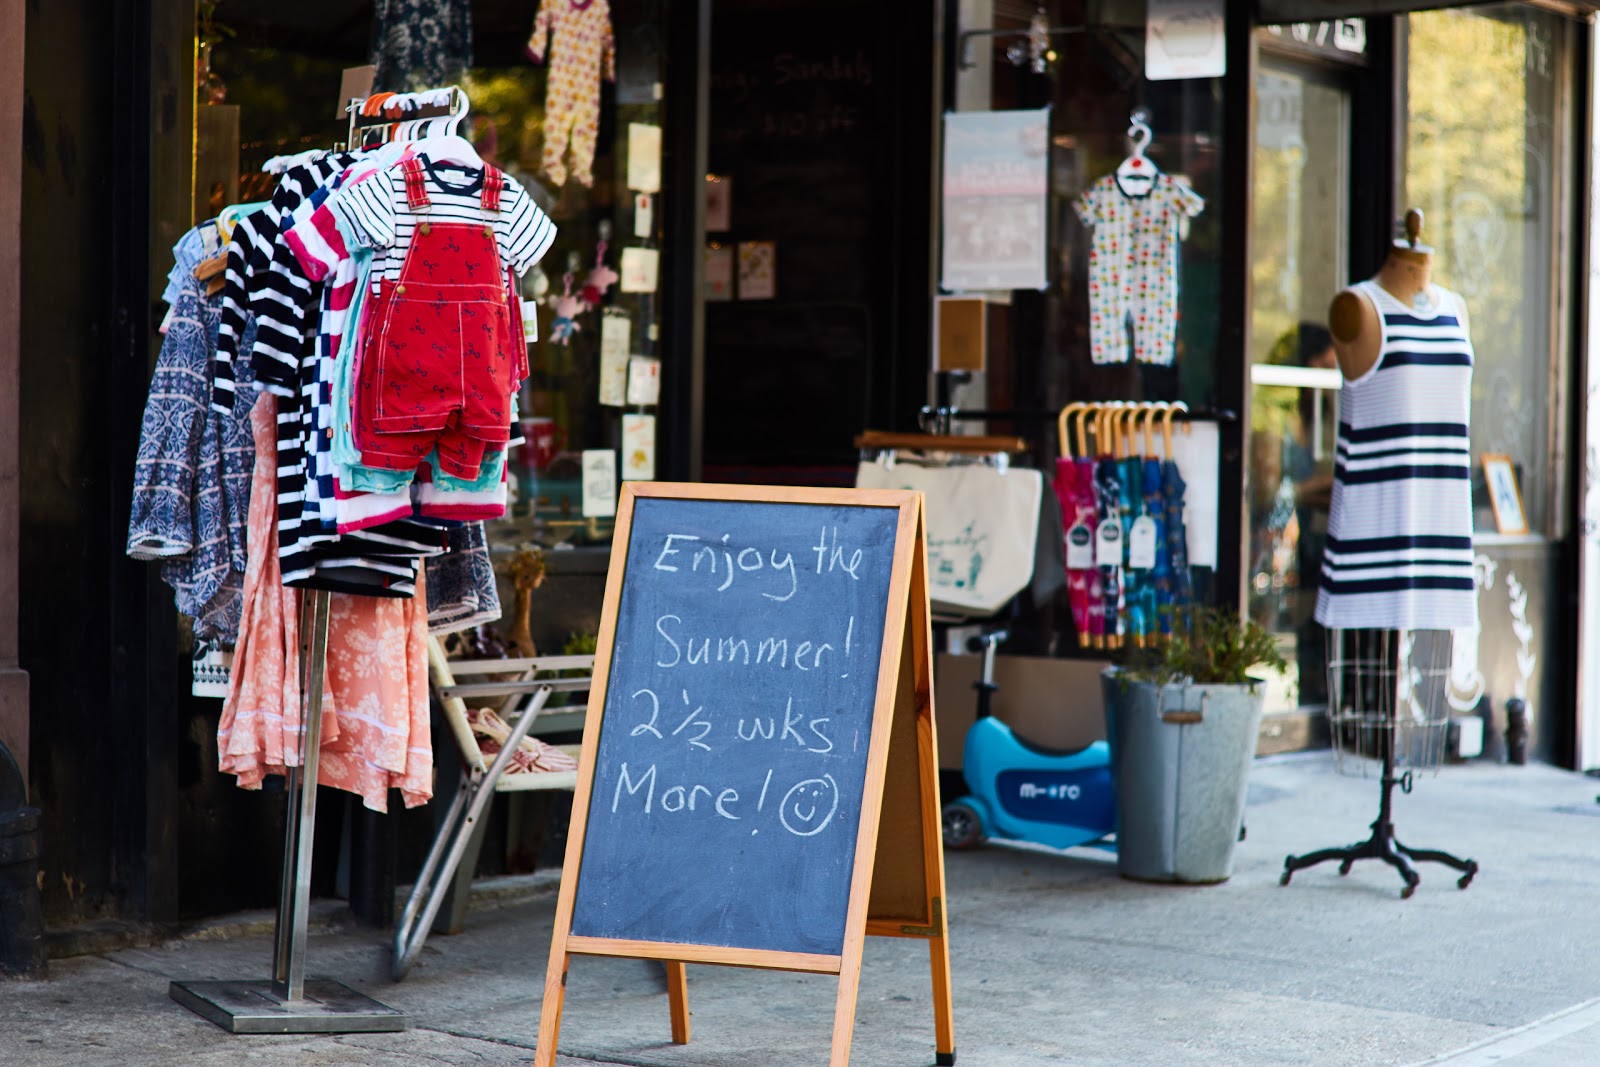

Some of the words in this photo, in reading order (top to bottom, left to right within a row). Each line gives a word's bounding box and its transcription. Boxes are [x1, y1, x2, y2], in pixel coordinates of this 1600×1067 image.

[654, 533, 798, 601] Enjoy
[812, 526, 863, 580] the
[655, 614, 854, 678] Summer!
[737, 696, 834, 753] wks
[611, 762, 773, 836] More!
